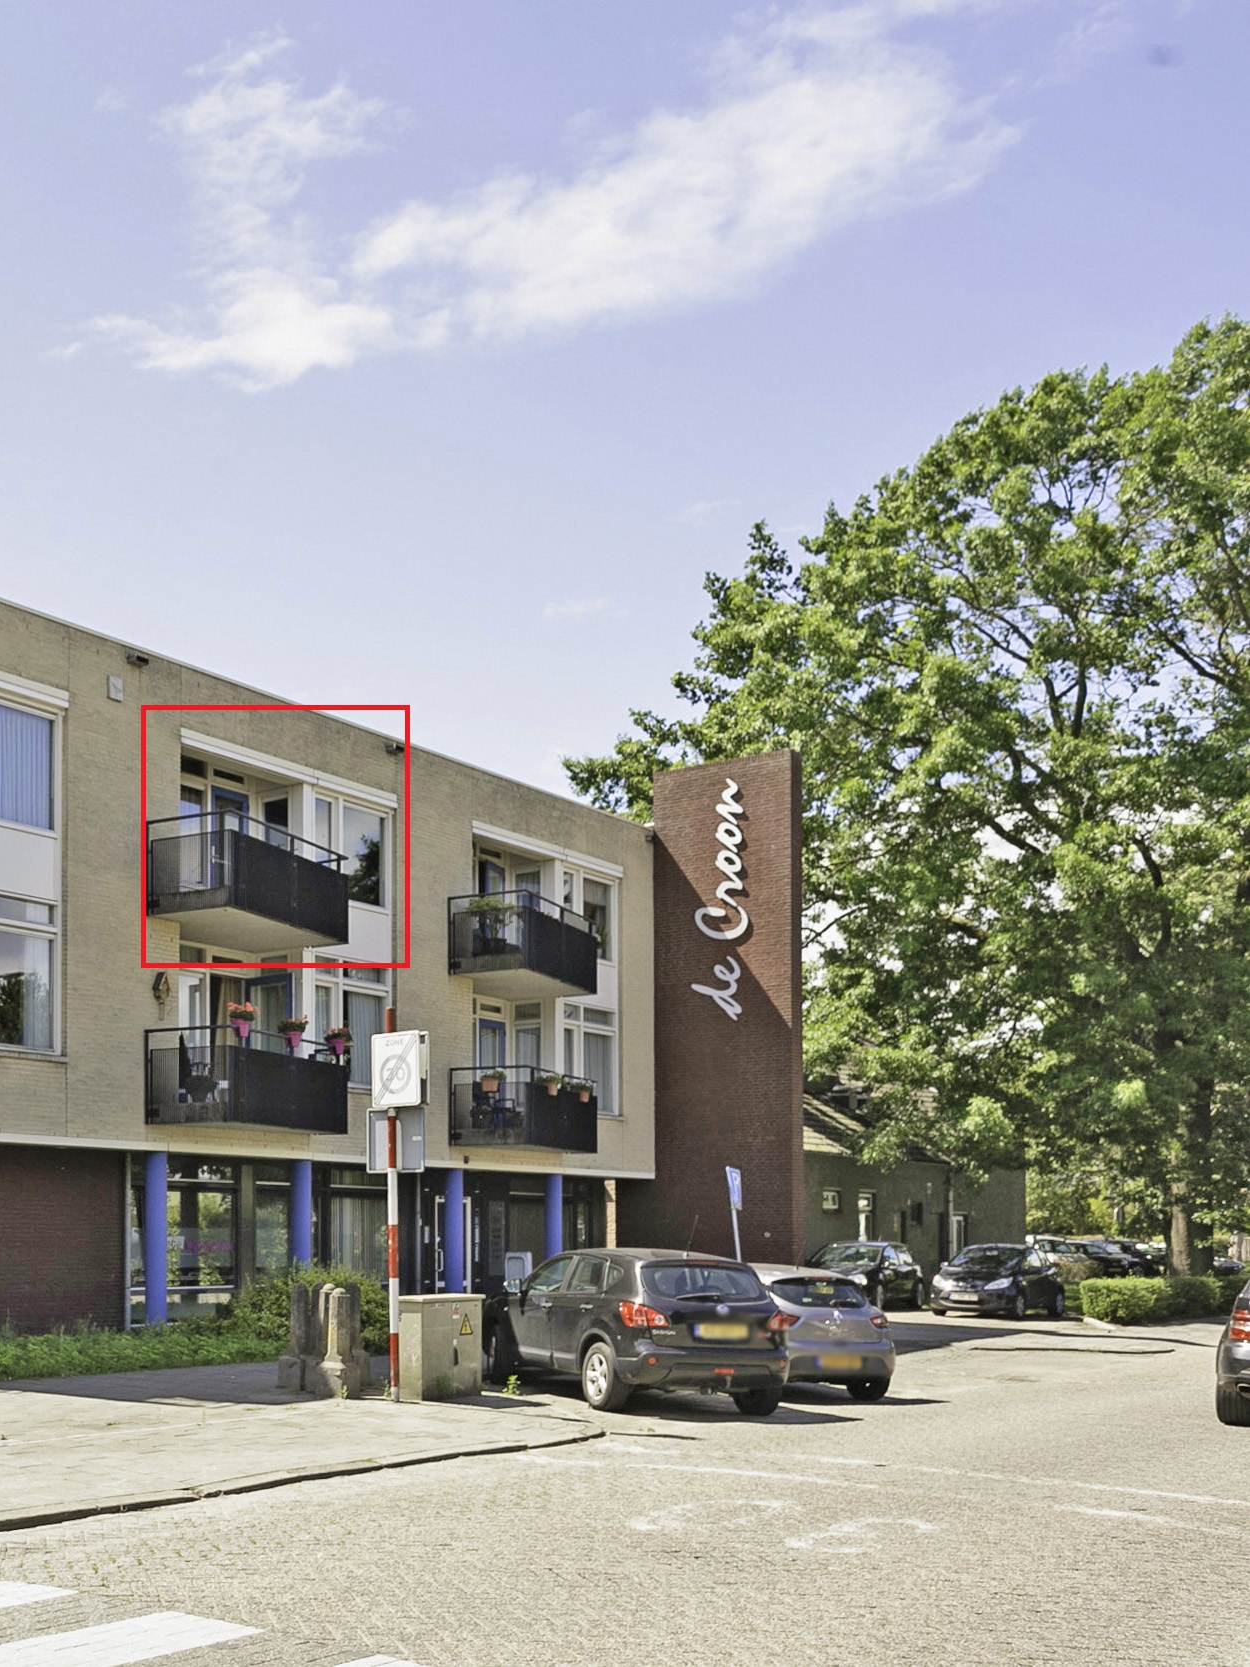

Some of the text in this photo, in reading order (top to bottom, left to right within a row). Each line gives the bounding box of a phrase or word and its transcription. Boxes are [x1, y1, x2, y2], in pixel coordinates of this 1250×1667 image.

[691, 777, 749, 1021] de Croon
[385, 1038, 404, 1047] ZONE
